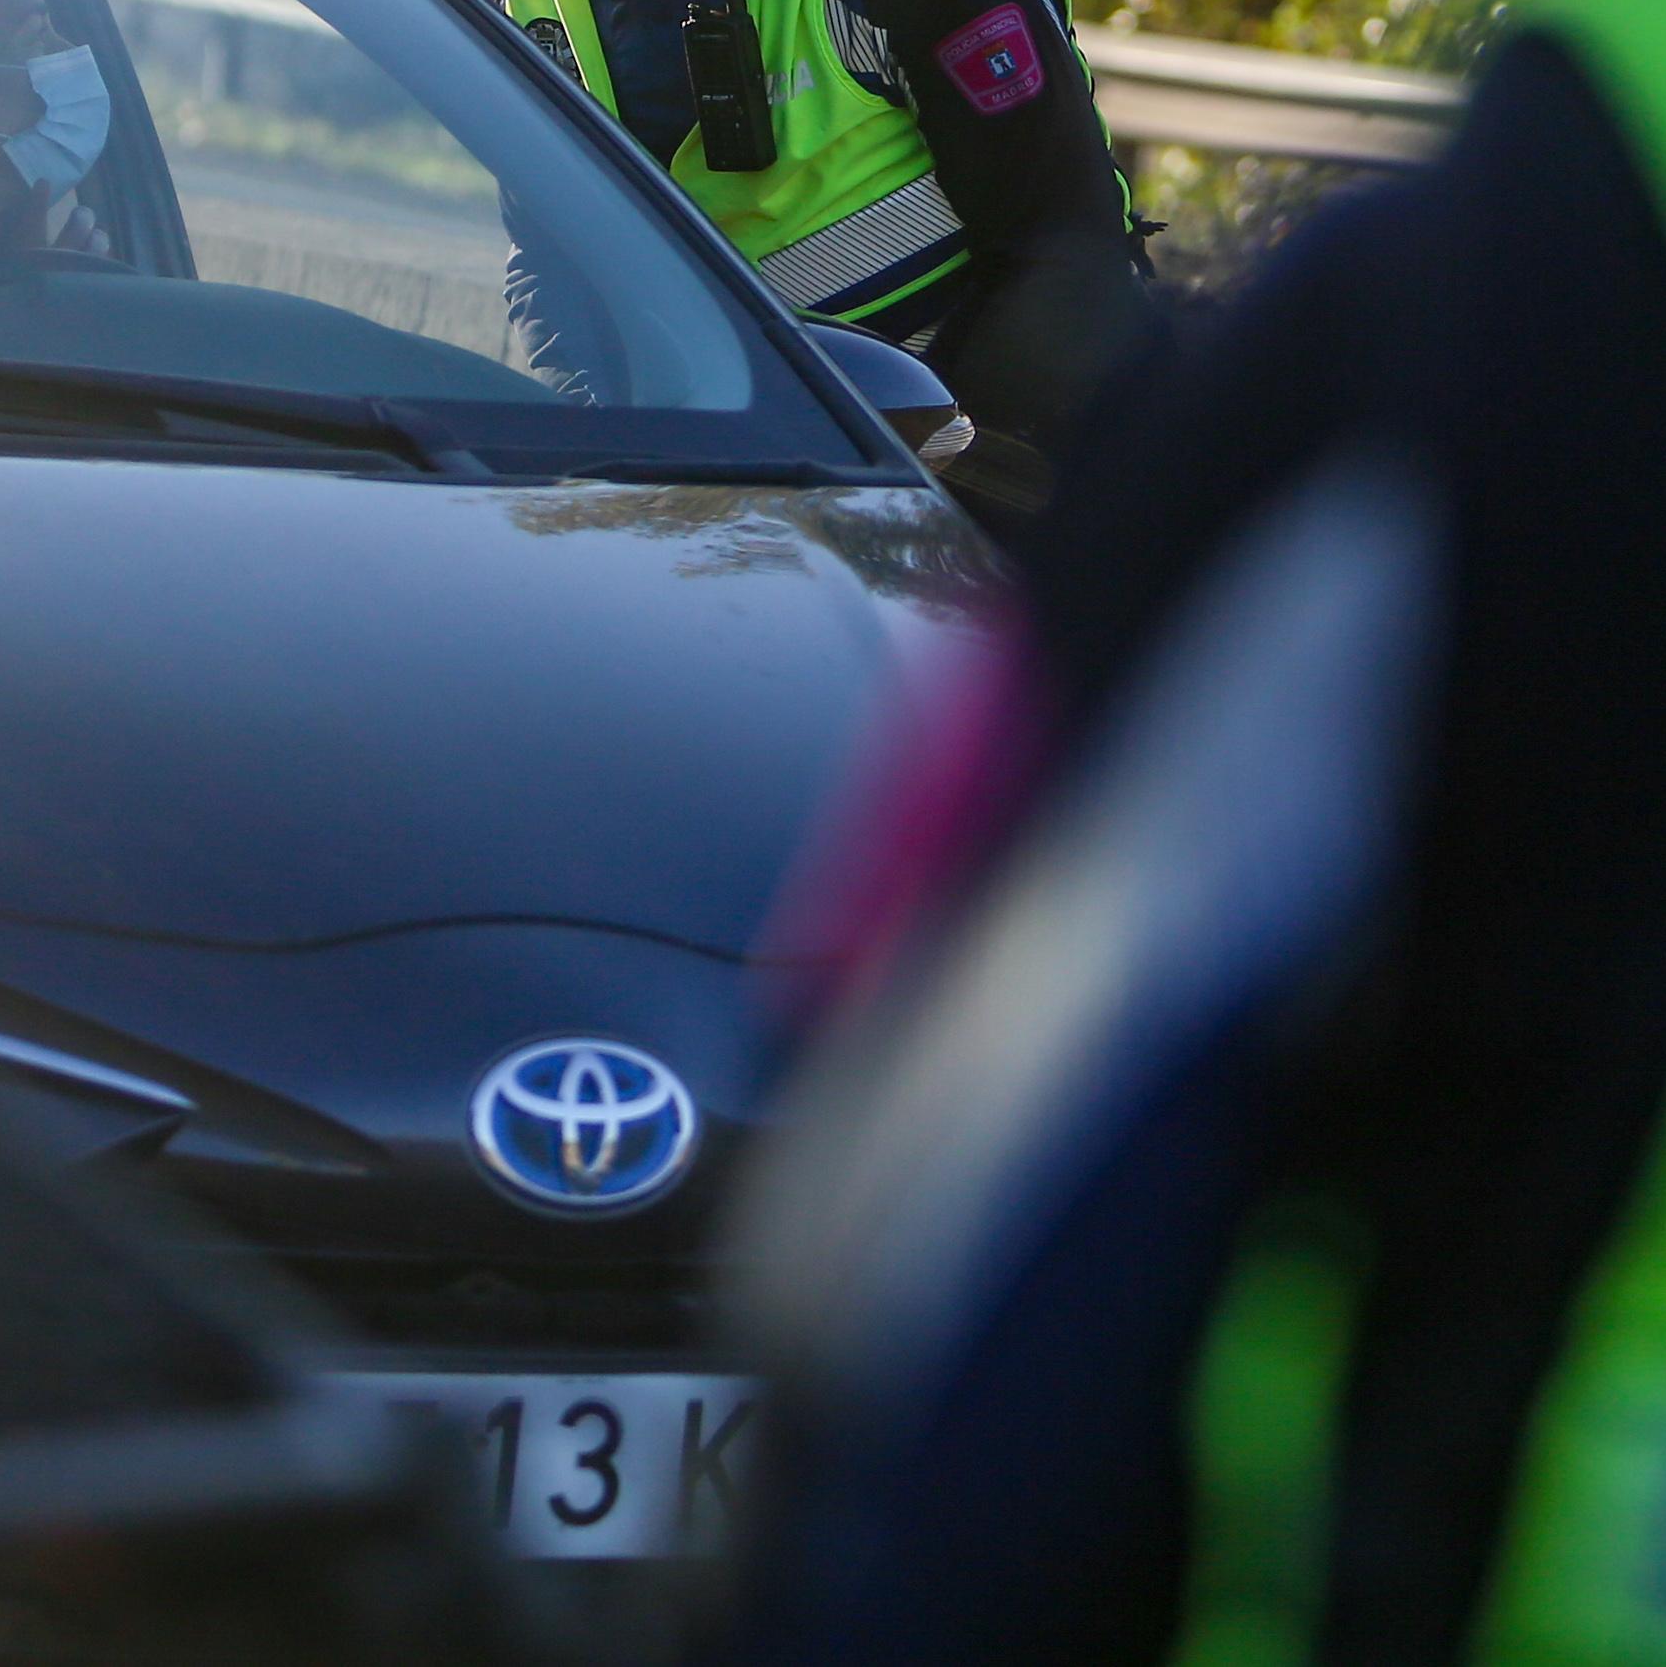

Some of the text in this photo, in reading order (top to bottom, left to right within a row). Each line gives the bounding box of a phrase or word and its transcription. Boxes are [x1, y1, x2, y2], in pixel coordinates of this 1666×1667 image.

[992, 77, 1034, 103] MADRID
[385, 1396, 755, 1528] 13 K
